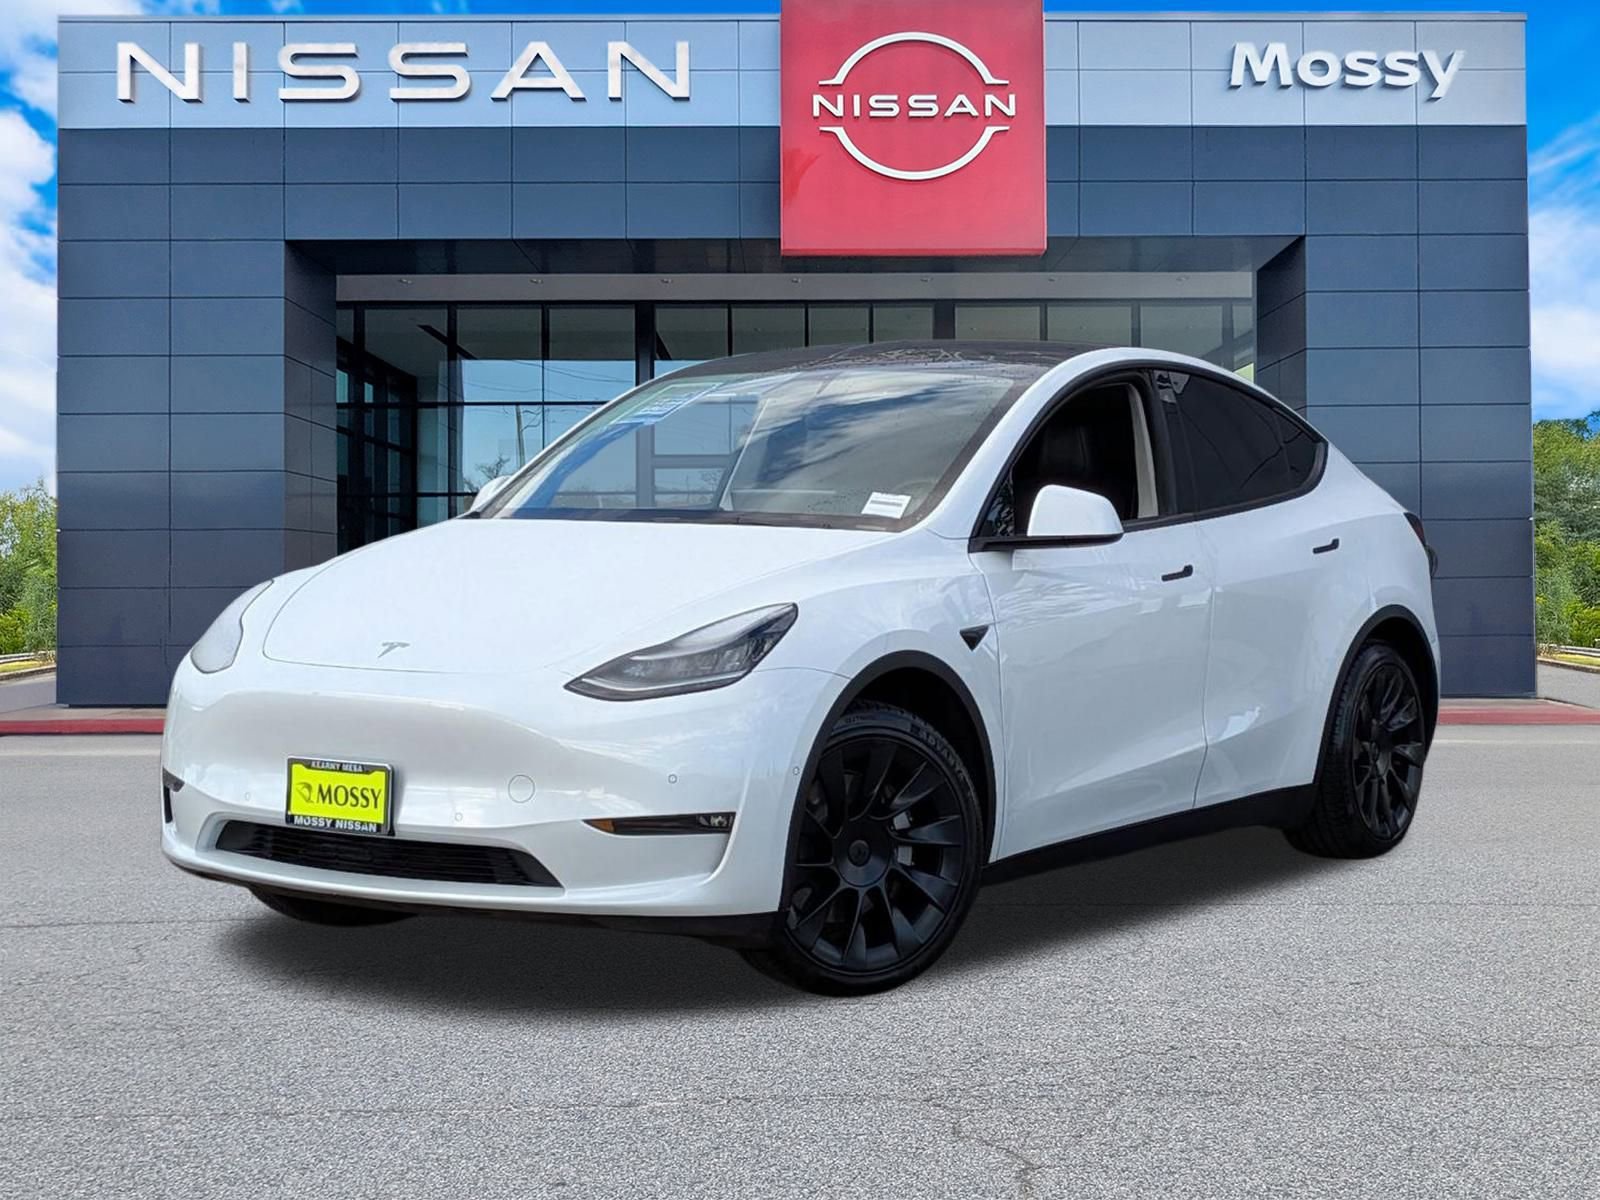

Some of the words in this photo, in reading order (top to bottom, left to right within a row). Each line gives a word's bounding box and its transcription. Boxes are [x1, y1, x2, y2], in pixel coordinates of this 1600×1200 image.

[116, 41, 691, 102] NISSAN
[1229, 42, 1466, 101] Mossy
[812, 94, 1016, 117] NISSAN
[316, 783, 382, 809] MOSSY
[294, 815, 333, 829] MOSSY
[335, 819, 377, 833] NISSAN
